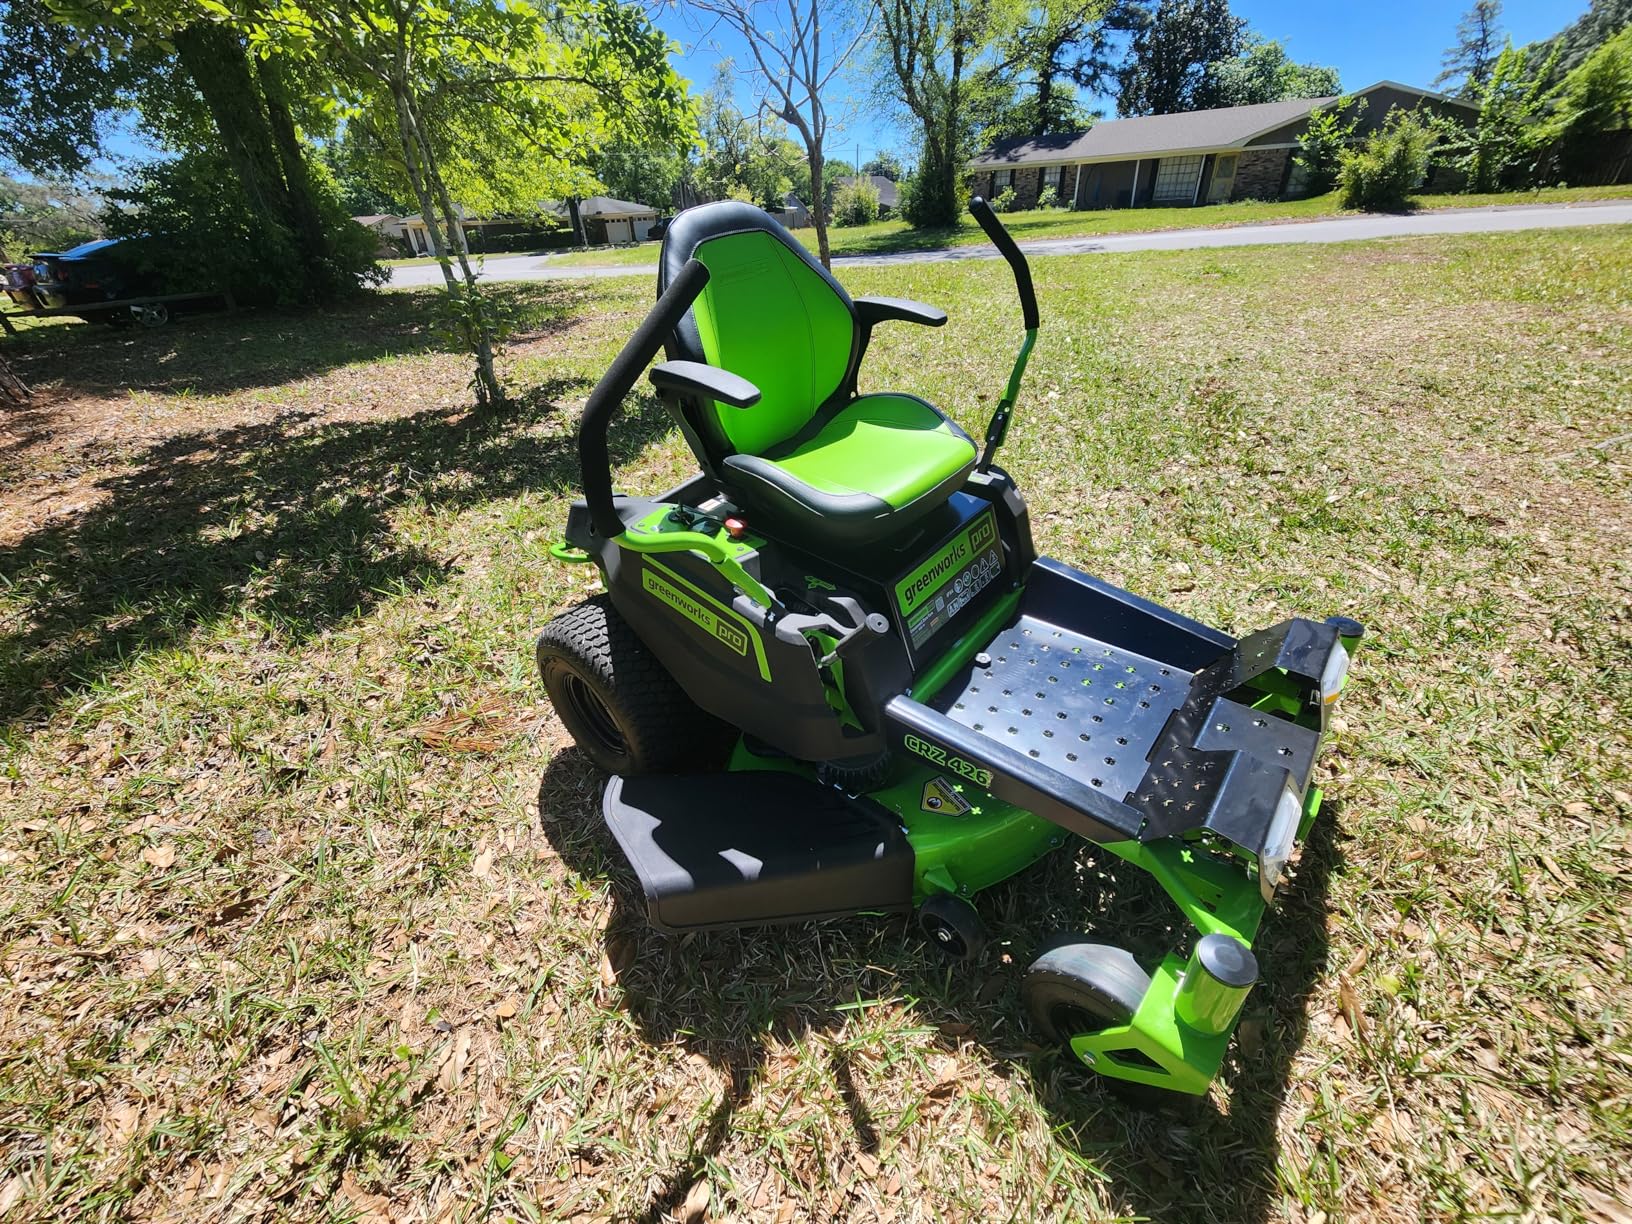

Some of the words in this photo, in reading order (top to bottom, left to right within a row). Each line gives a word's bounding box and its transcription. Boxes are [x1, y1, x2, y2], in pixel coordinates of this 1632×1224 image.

[904, 543, 966, 606] greenworks
[971, 522, 991, 550] pro
[648, 578, 711, 625] greenworks
[719, 625, 742, 647] pro
[904, 734, 946, 766] CRZ
[947, 757, 993, 788] 426
